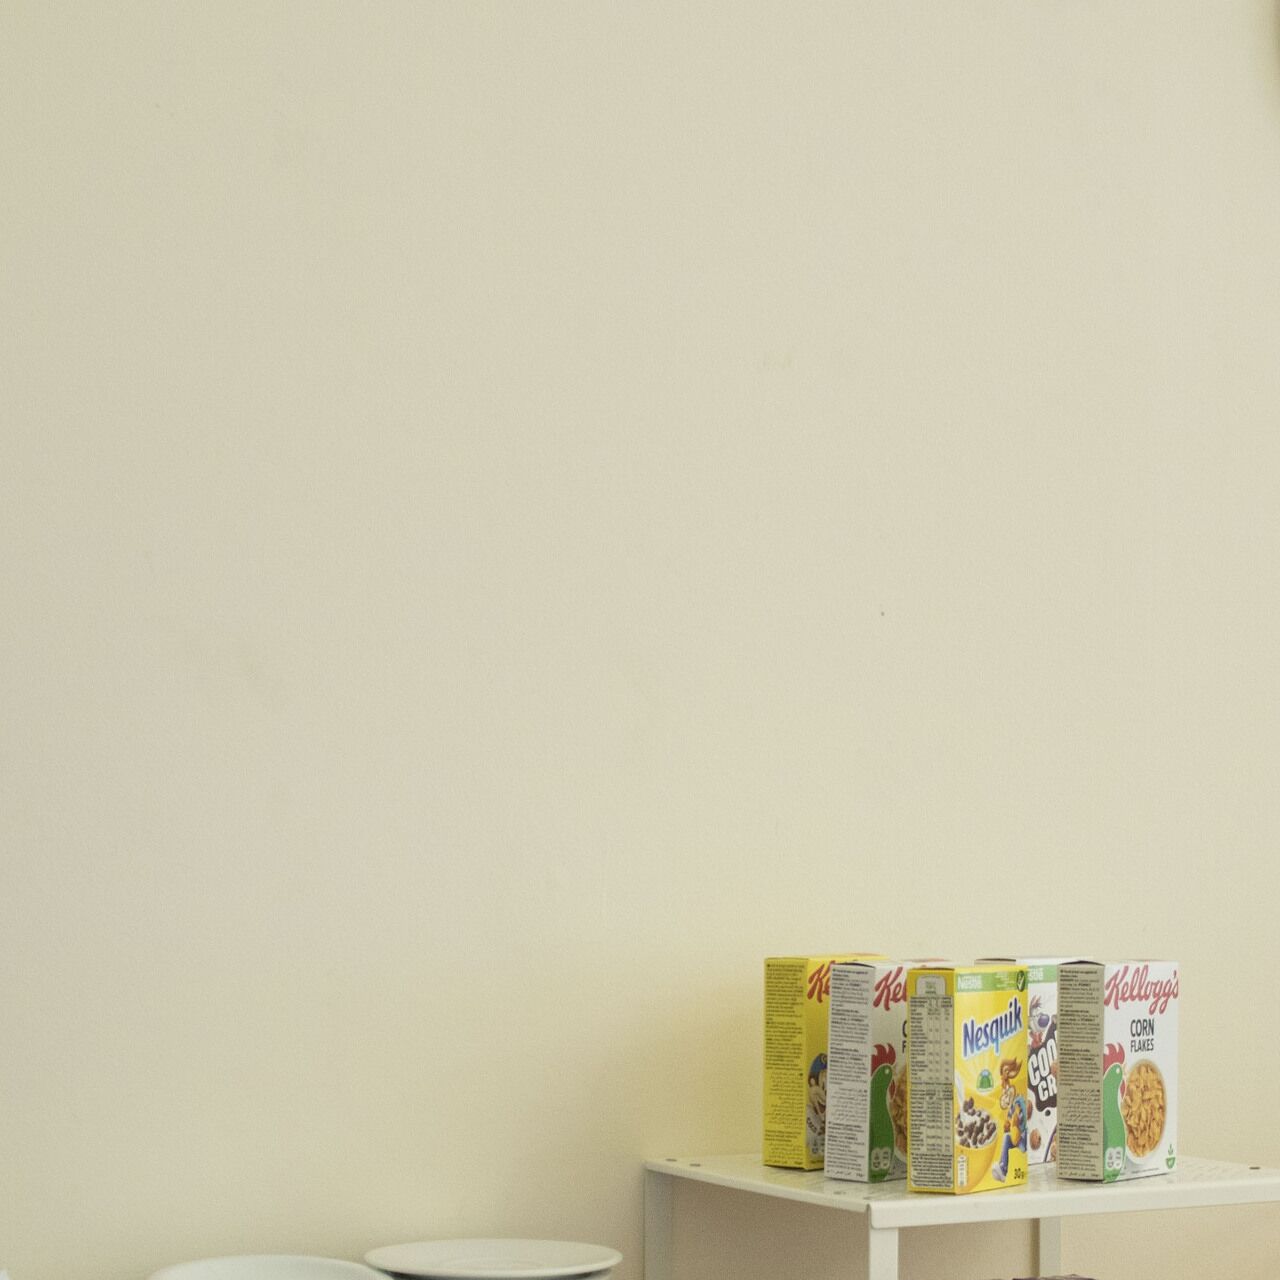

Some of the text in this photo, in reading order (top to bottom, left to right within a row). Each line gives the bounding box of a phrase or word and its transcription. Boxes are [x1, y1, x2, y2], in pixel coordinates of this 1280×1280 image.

[1104, 965, 1179, 1015] Kellogg's
[963, 998, 1022, 1057] Nesquik
[1130, 1019, 1155, 1037] CORN
[1130, 1039, 1154, 1052] FLAKES
[1028, 1038, 1057, 1086] COO
